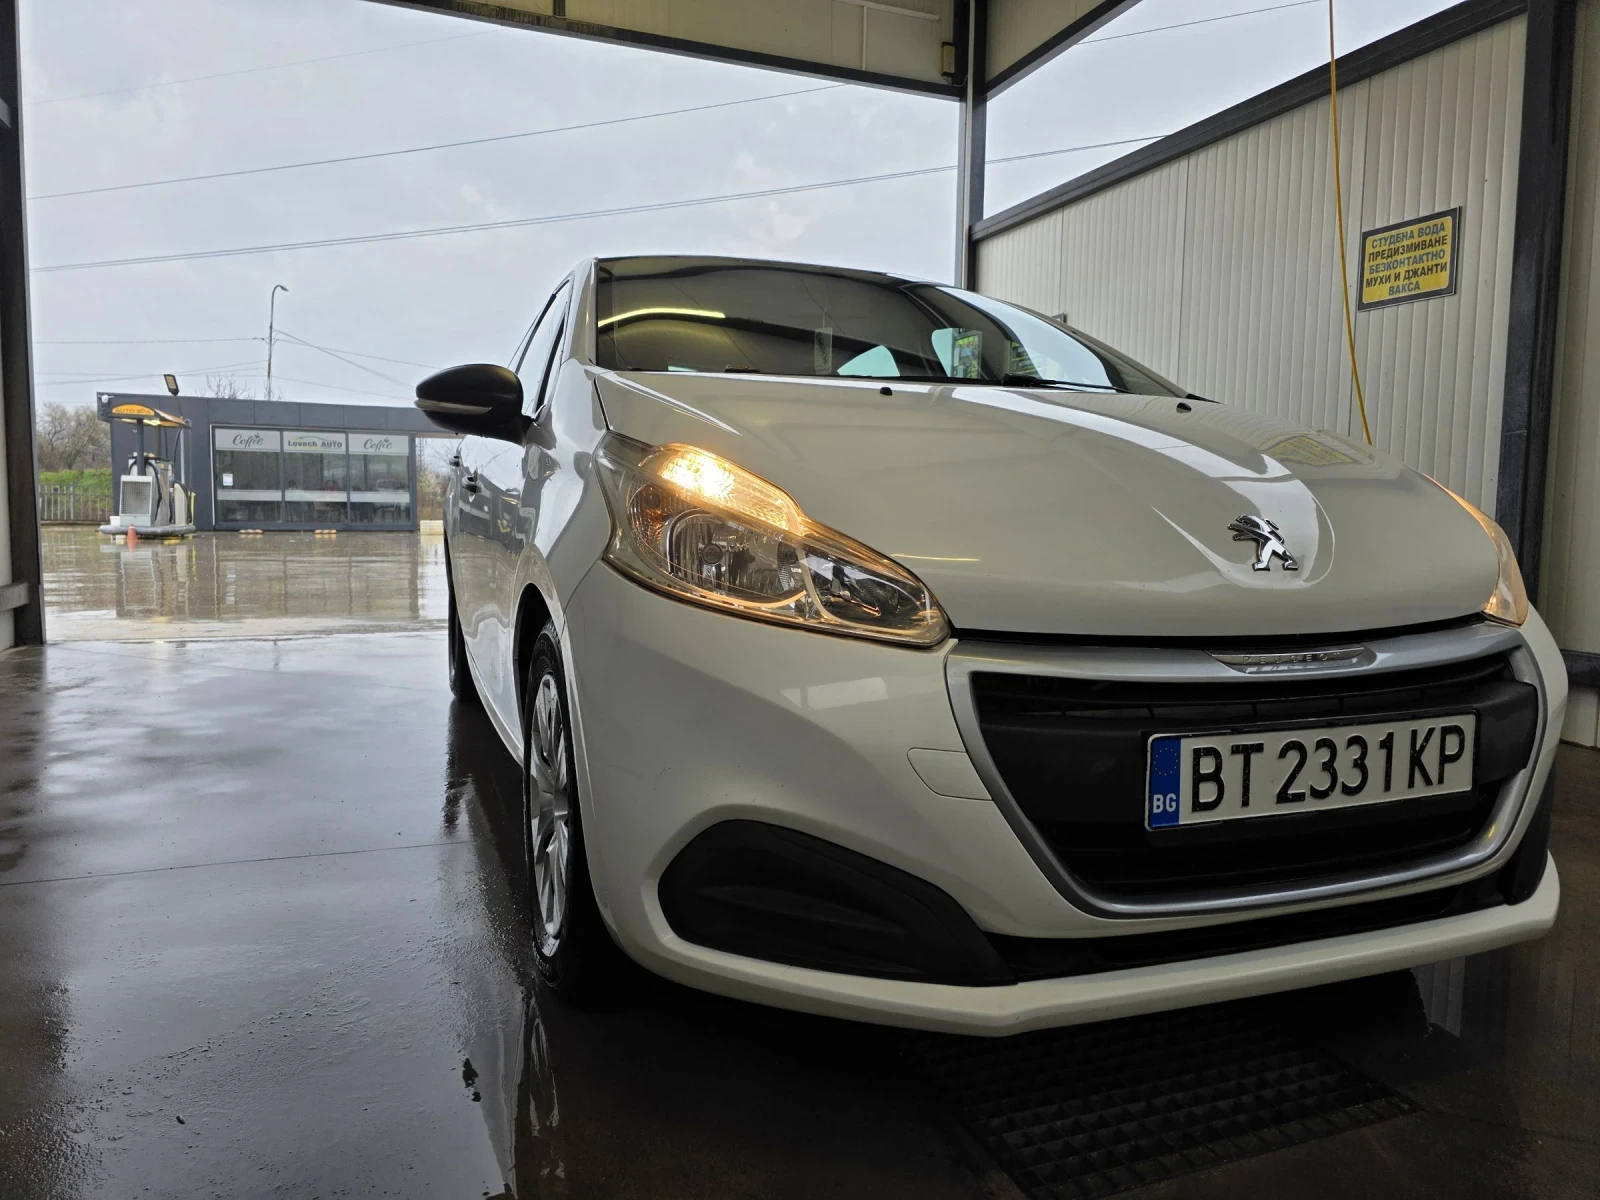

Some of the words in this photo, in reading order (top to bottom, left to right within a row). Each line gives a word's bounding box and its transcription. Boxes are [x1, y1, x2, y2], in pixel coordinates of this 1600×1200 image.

[1368, 234, 1448, 262] ПРЕДИЗМИВАНЕ
[1371, 229, 1415, 249] СТУДЕНА
[1417, 222, 1446, 238] ВОДА
[1365, 274, 1391, 288] МУХИ
[1394, 271, 1401, 282] И
[1403, 262, 1447, 282] ДЖАНТИ
[1368, 249, 1446, 275] БЕЗКОНТАКТНО
[1388, 281, 1420, 296] ВАКСА
[232, 433, 264, 448] Coffee
[288, 440, 318, 448] Lovech
[321, 441, 343, 449] AUTO
[363, 438, 393, 452] Coffee
[1153, 793, 1177, 814] BG
[1191, 741, 1265, 813] BT
[1275, 731, 1395, 805] 2331
[1407, 724, 1466, 789] KP
